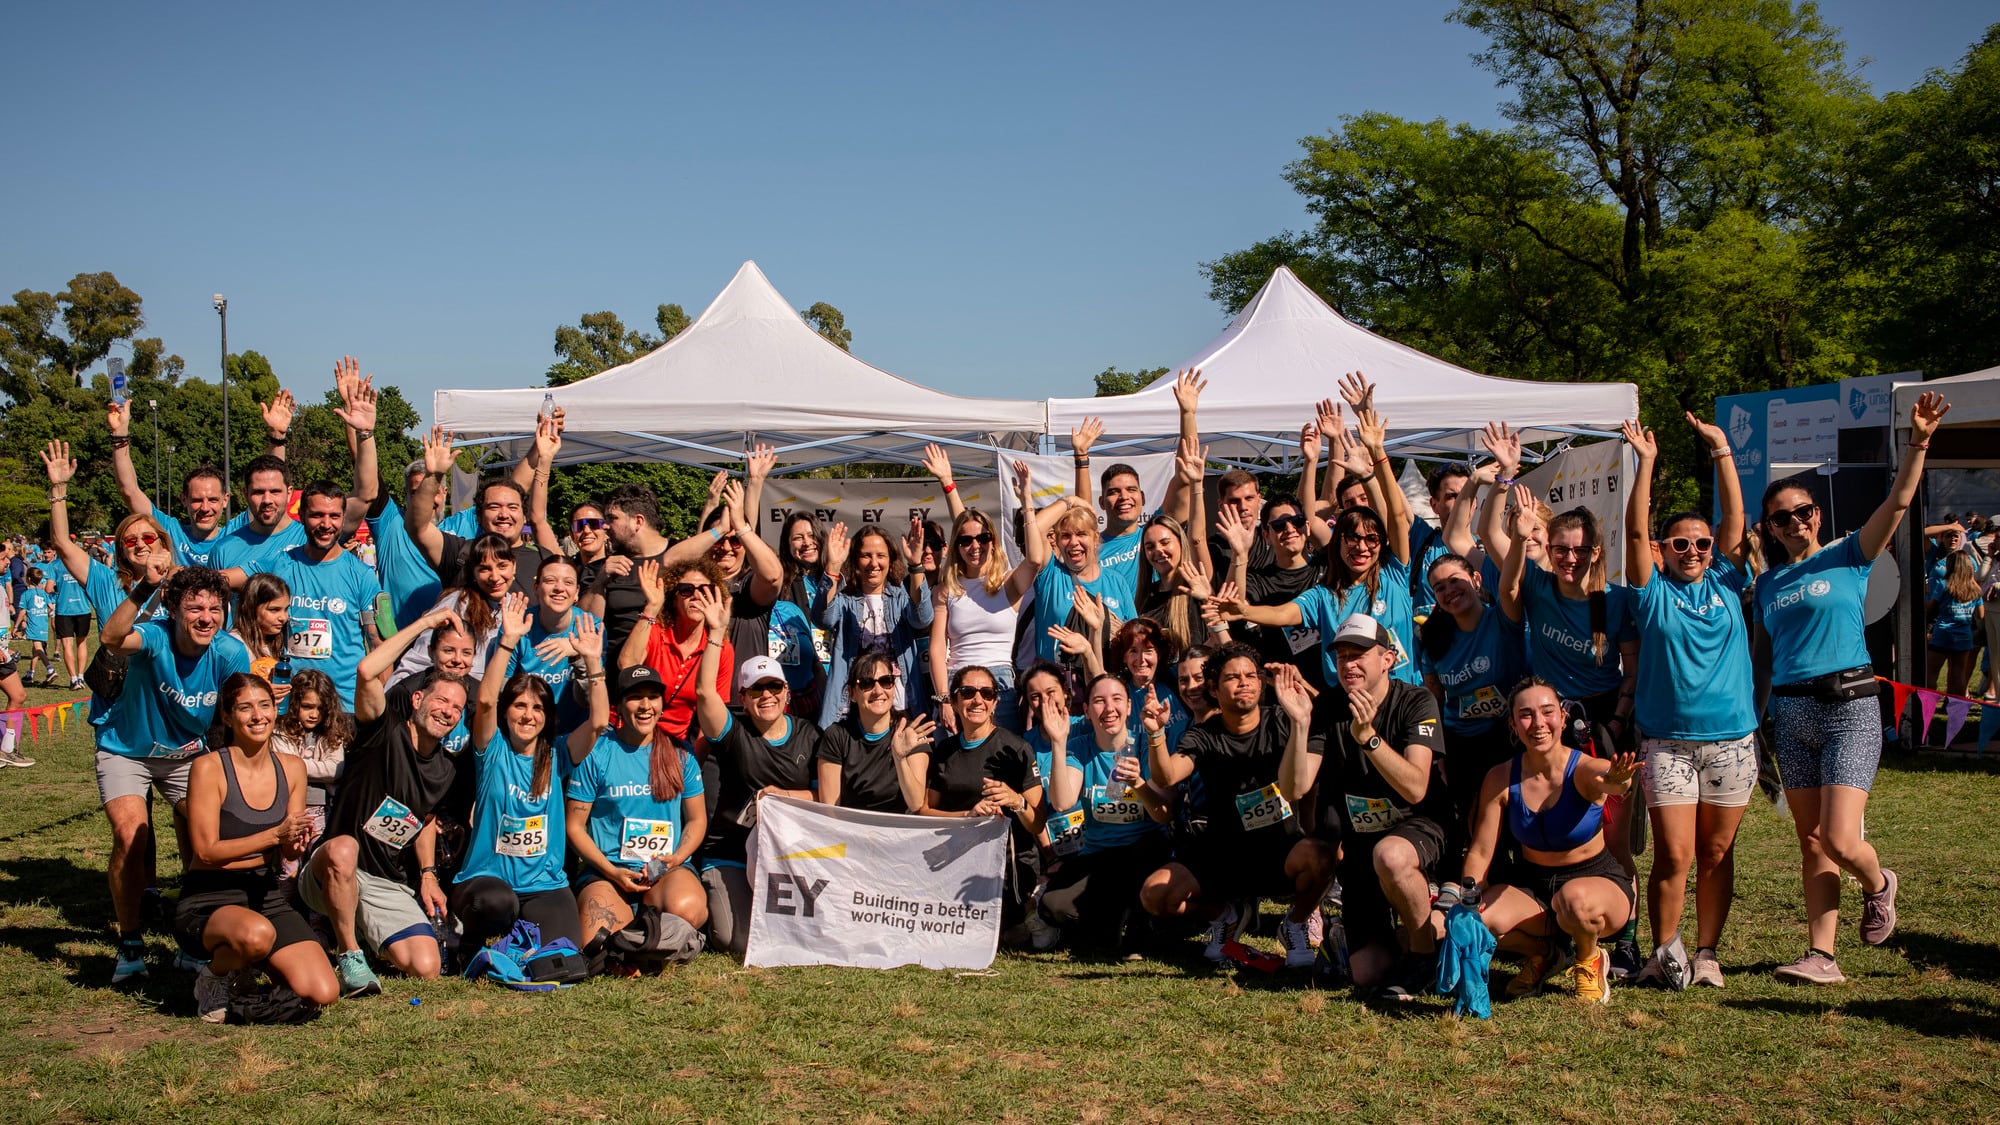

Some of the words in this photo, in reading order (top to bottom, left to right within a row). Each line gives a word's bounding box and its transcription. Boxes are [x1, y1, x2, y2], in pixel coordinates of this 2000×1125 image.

[1549, 487, 1564, 504] EY
[1569, 483, 1576, 500] EY
[1580, 480, 1587, 497] EY
[1592, 478, 1600, 496] EY
[1607, 475, 1619, 493] EY
[770, 508, 792, 522] EY
[815, 508, 837, 522] EY
[862, 508, 884, 523] EY
[909, 507, 931, 522] EY
[1763, 584, 1806, 618] unicef
[293, 632, 322, 647] 917
[1542, 623, 1591, 655] unicef
[528, 669, 567, 684] icef
[1418, 724, 1435, 738] EY
[1032, 766, 1041, 778] E
[610, 781, 652, 798] unice
[1096, 802, 1139, 815] 5398
[1352, 809, 1391, 824] 5617
[379, 815, 410, 837] 935
[529, 820, 539, 828] 2K
[1072, 814, 1083, 823] 2K
[655, 825, 665, 833] 2K
[501, 830, 543, 846] 5585
[627, 835, 668, 851] 5967
[765, 872, 830, 918] EY
[853, 891, 919, 916] Building
[923, 901, 933, 914] a
[938, 901, 988, 921] better
[851, 909, 916, 933] working
[921, 919, 966, 935] world
